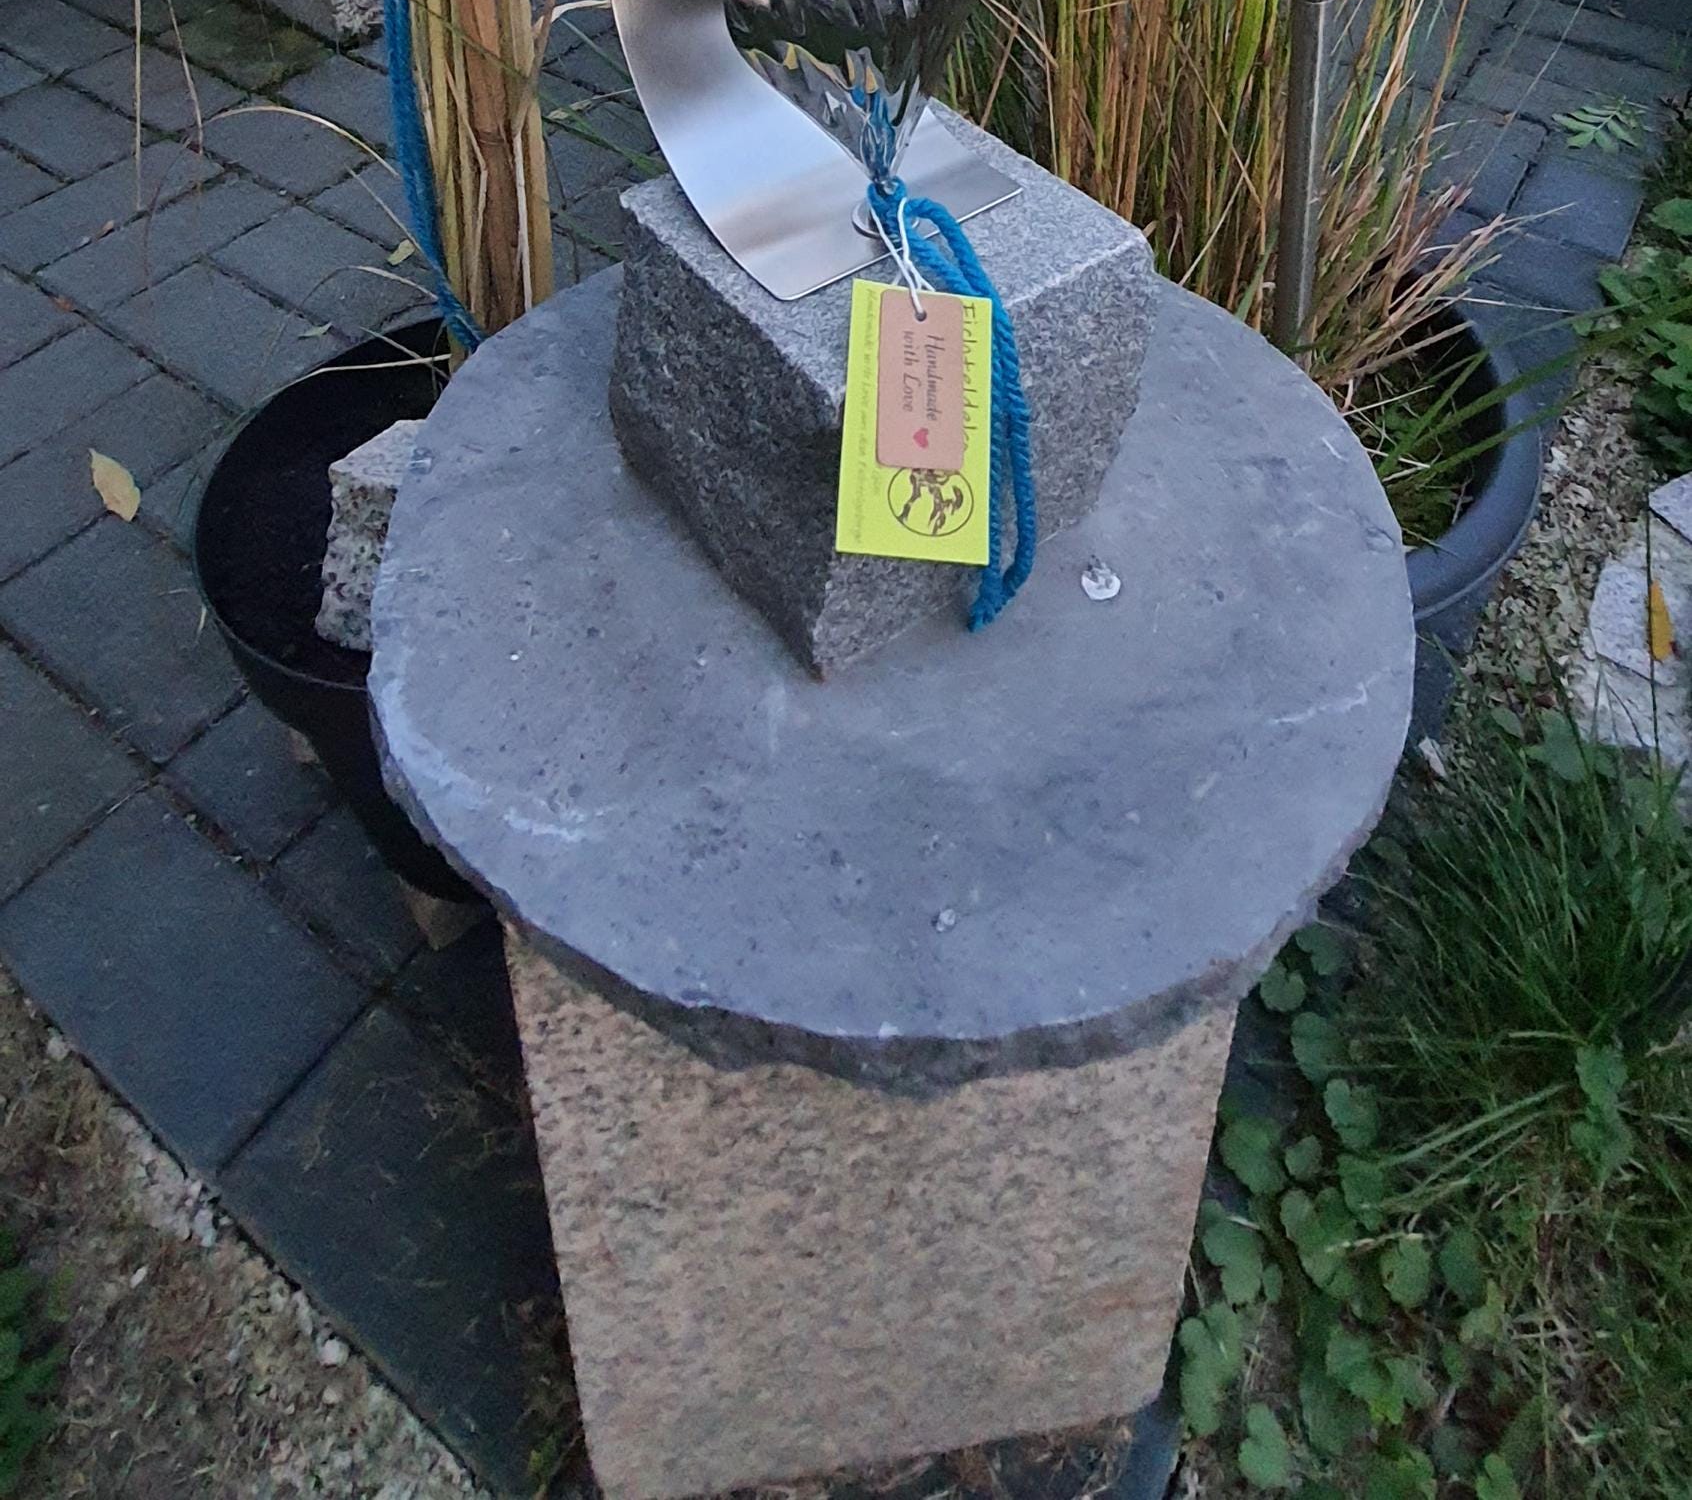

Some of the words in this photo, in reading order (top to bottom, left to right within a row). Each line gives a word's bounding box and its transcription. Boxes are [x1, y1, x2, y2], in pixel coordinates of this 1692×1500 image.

[902, 331, 920, 367] with
[902, 373, 922, 412] Love
[926, 334, 944, 422] Handmade
